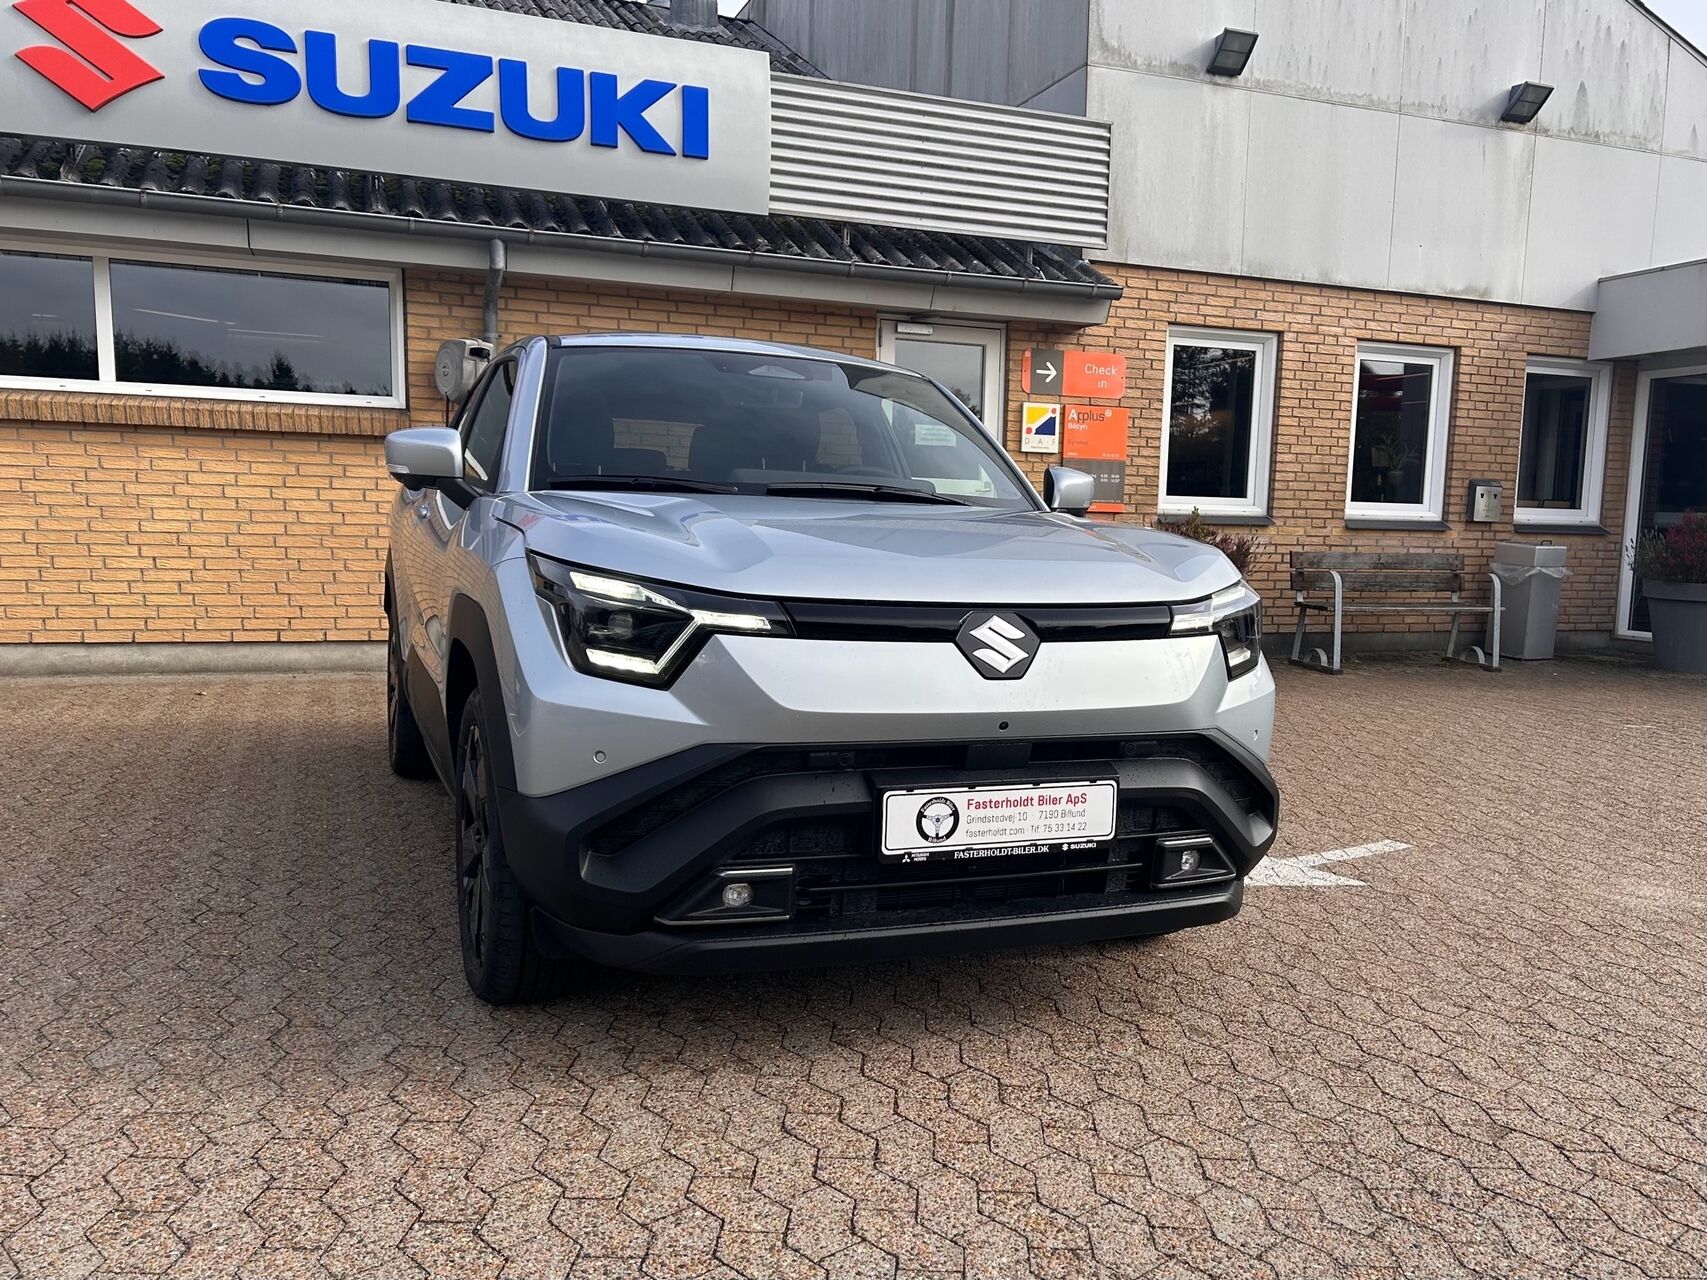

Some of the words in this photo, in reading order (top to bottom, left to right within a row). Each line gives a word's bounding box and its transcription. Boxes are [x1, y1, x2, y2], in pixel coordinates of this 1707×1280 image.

[198, 17, 709, 160] SUZUKI
[1085, 363, 1117, 375] Check
[1097, 380, 1107, 388] in
[967, 797, 1034, 810] Fasterholdt
[1037, 794, 1063, 806] Biler
[1065, 792, 1087, 807] ApS
[966, 813, 1015, 825] Grindstedvej
[1018, 811, 1028, 821] 10
[1038, 809, 1059, 820] 7190
[965, 828, 1025, 838] fasterholdtcom
[1043, 823, 1053, 833] 75
[1055, 822, 1065, 832] 33
[1067, 822, 1076, 831] 14
[1077, 821, 1087, 831] 22
[954, 845, 1049, 859] FASTERHOLDT-BILER.DK
[1070, 842, 1097, 850] SUZUKI
